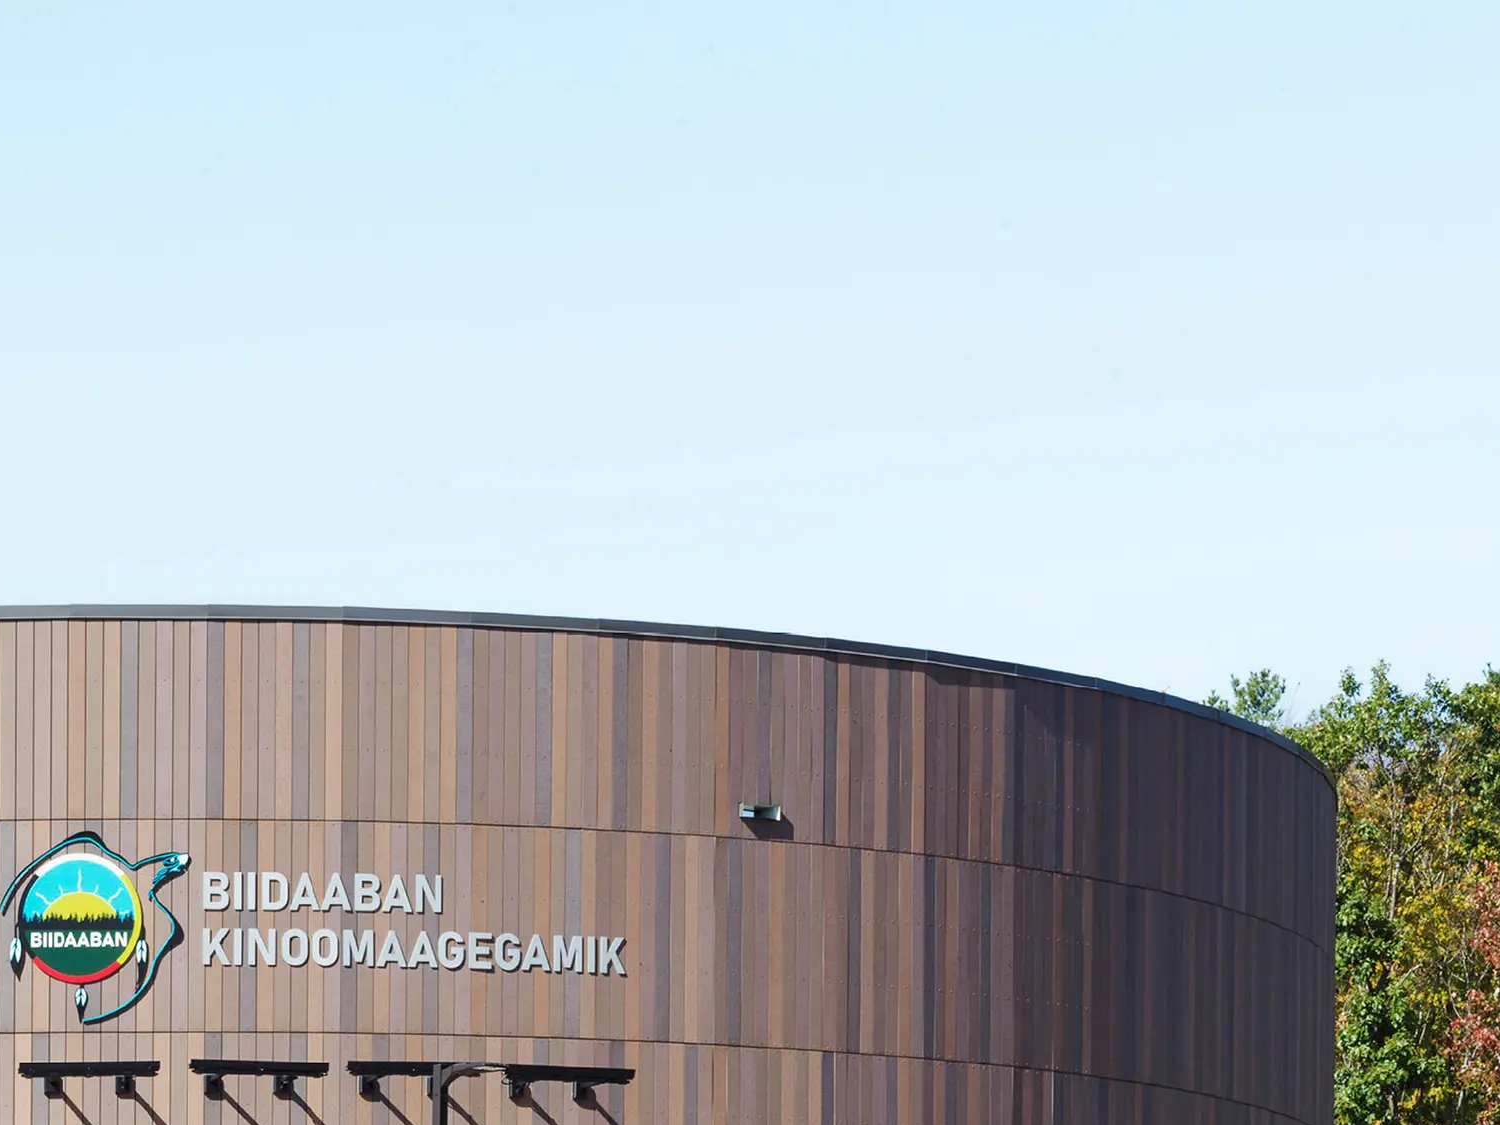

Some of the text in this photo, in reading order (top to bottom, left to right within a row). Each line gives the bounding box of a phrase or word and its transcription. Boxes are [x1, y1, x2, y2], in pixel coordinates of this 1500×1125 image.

[202, 871, 443, 913] BIIDAABAN
[30, 931, 128, 948] BIIDAABAN
[202, 928, 627, 976] KINOOMAAGEGAMIK
